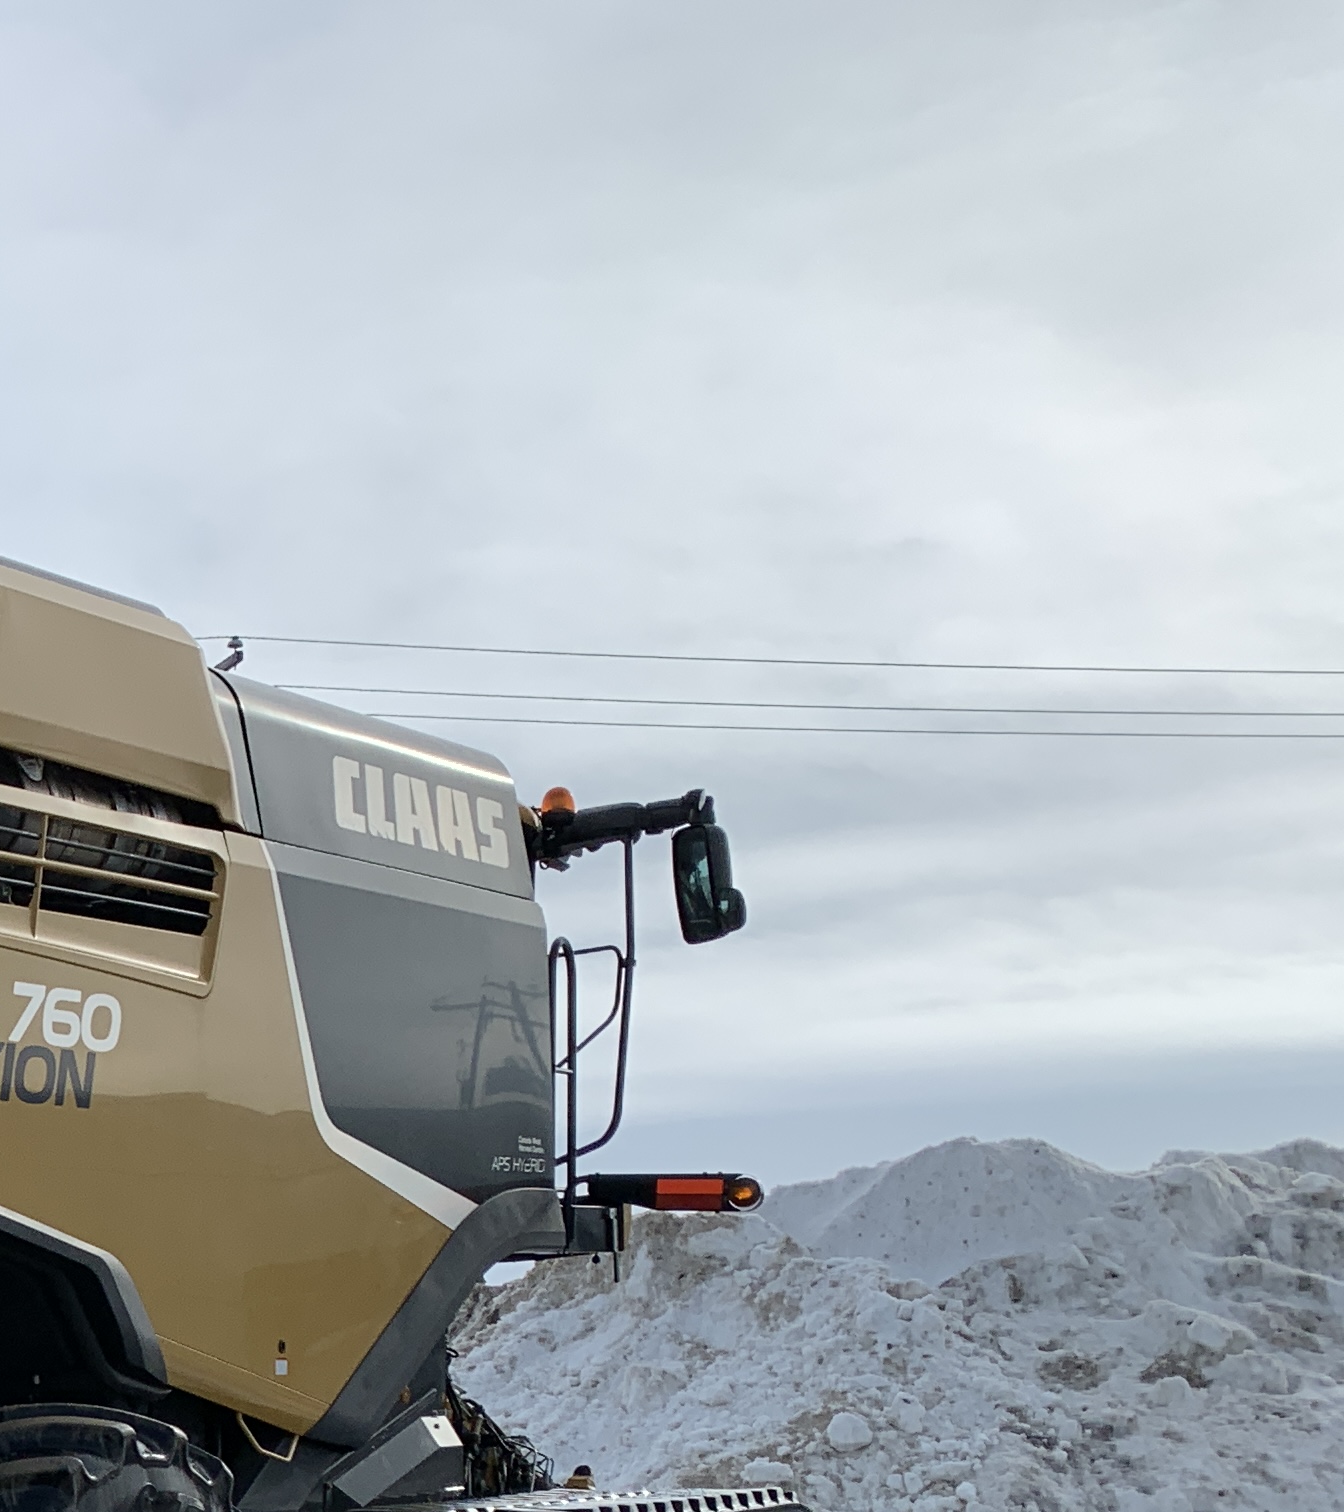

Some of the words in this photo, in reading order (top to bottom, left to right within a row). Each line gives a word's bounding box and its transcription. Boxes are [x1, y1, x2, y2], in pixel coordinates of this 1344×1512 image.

[333, 755, 510, 869] CLAAS
[8, 981, 122, 1053] 760
[491, 1156, 511, 1172] APS
